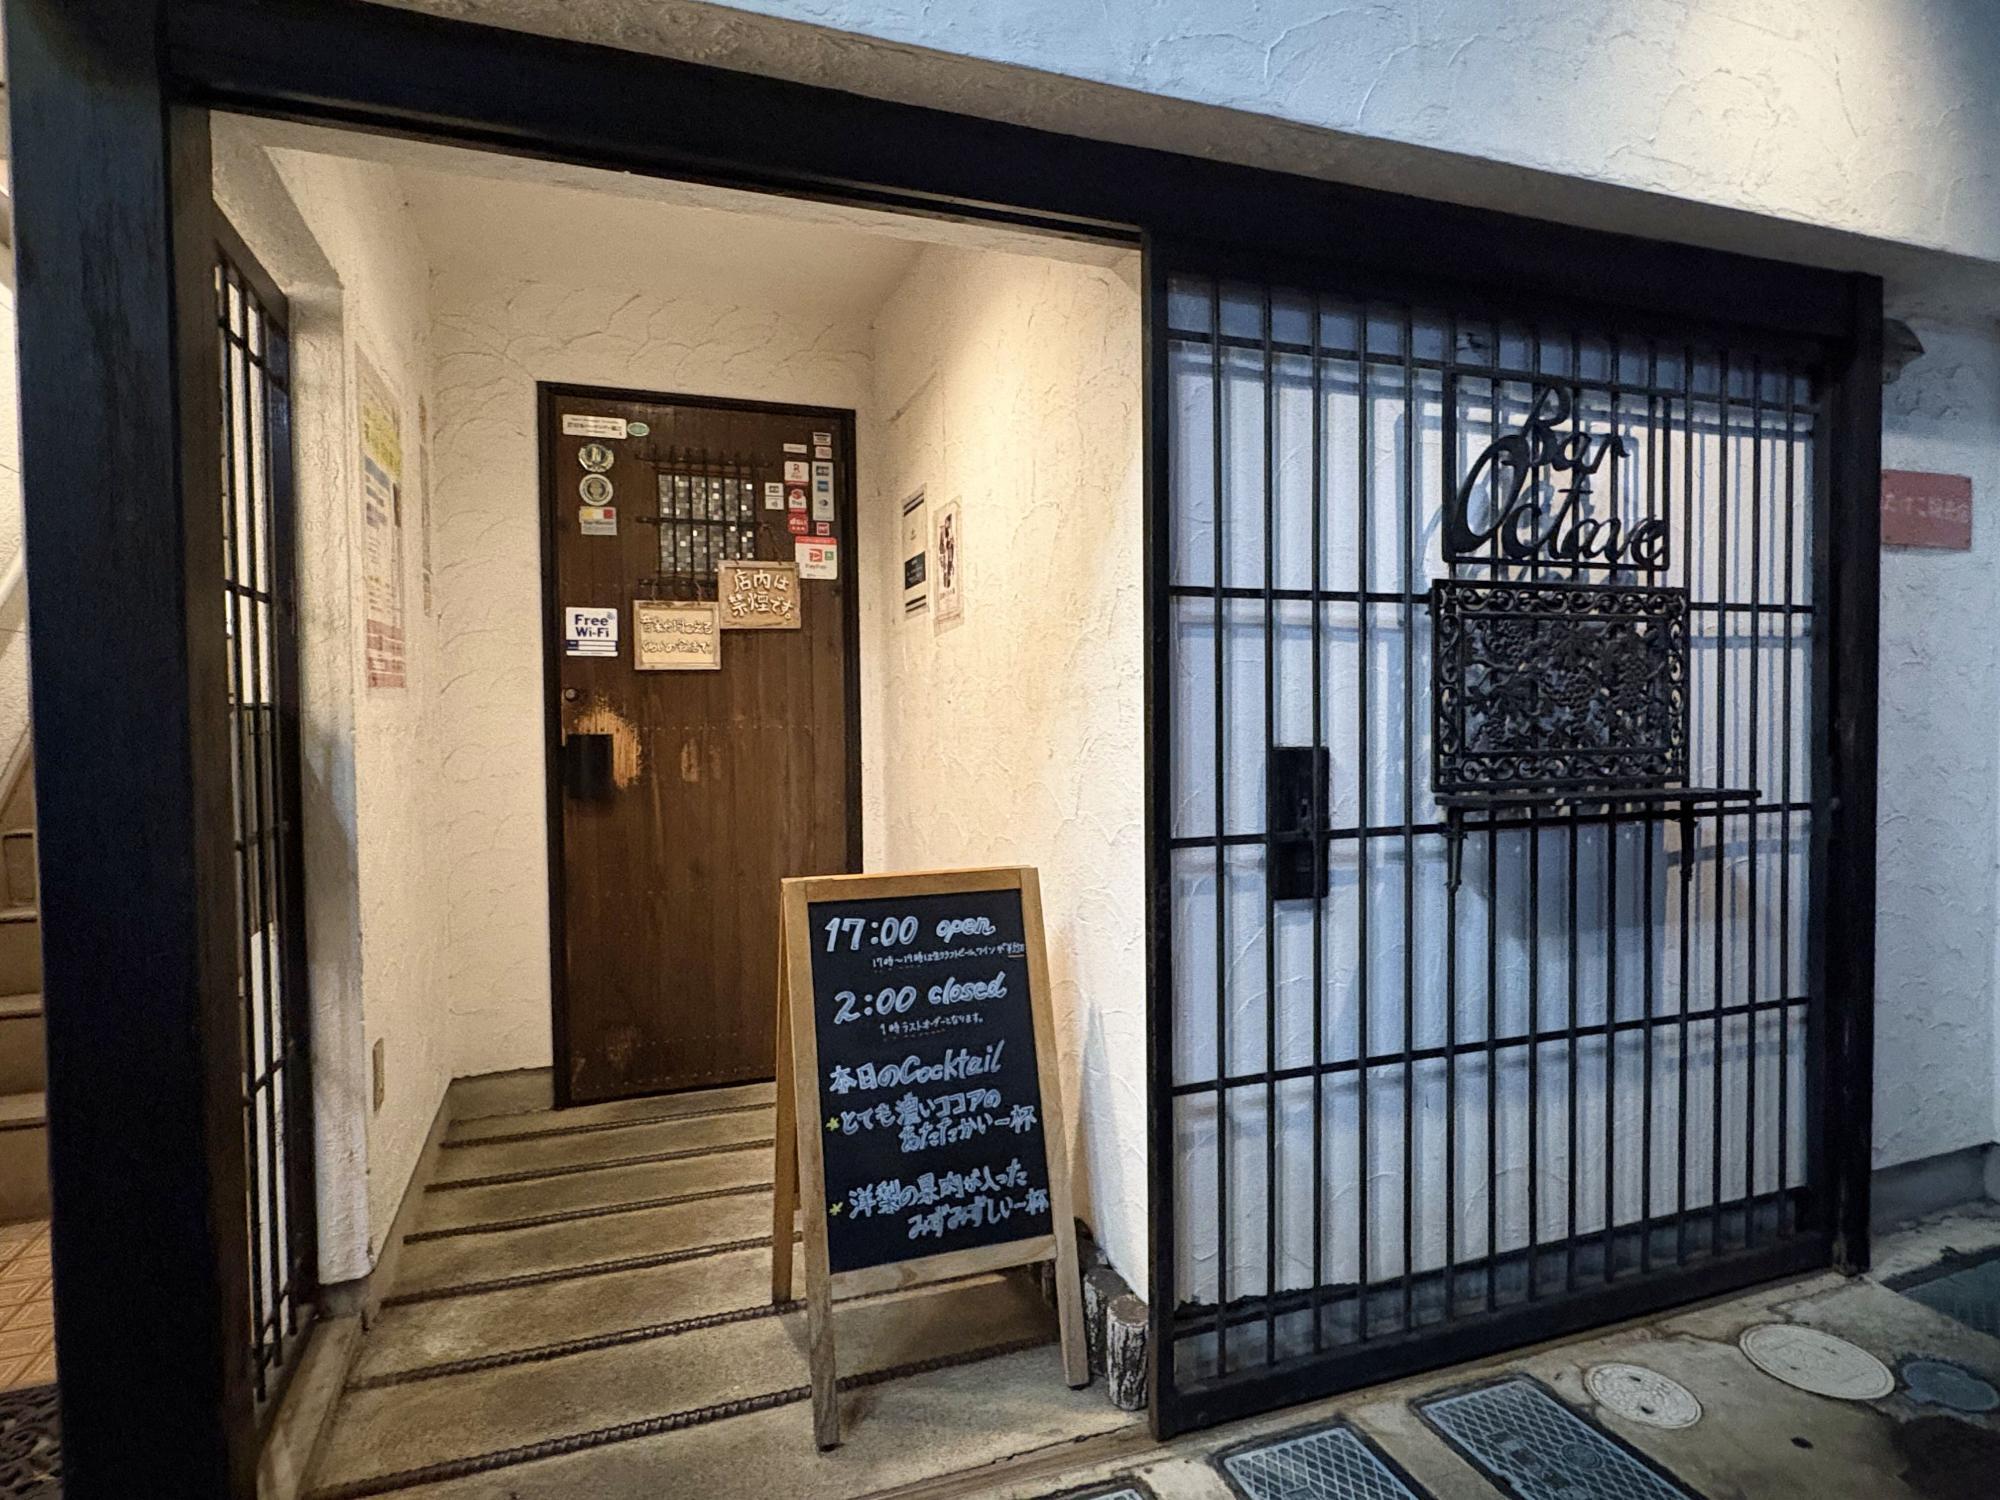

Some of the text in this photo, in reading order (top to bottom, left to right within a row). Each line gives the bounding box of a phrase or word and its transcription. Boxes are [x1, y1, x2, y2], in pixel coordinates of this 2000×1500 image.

[1521, 386, 1631, 474] Bar
[1450, 434, 1670, 566] Octave
[734, 568, 790, 592] 店内は
[574, 613, 609, 626] Free
[728, 590, 794, 620] 禁煙です。
[575, 626, 610, 638] Wi-Fi
[824, 915, 996, 953] 17:00 open
[833, 971, 1008, 1025] 2:00 closed
[829, 1040, 1005, 1095] 本日のCocktail
[840, 1088, 1002, 1135] とても濃いココアの
[898, 1104, 1038, 1153] あたたかい一杯
[848, 1157, 1028, 1219] 洋梨の果肉が入った
[907, 1188, 1050, 1240] みずみずしい一杯
